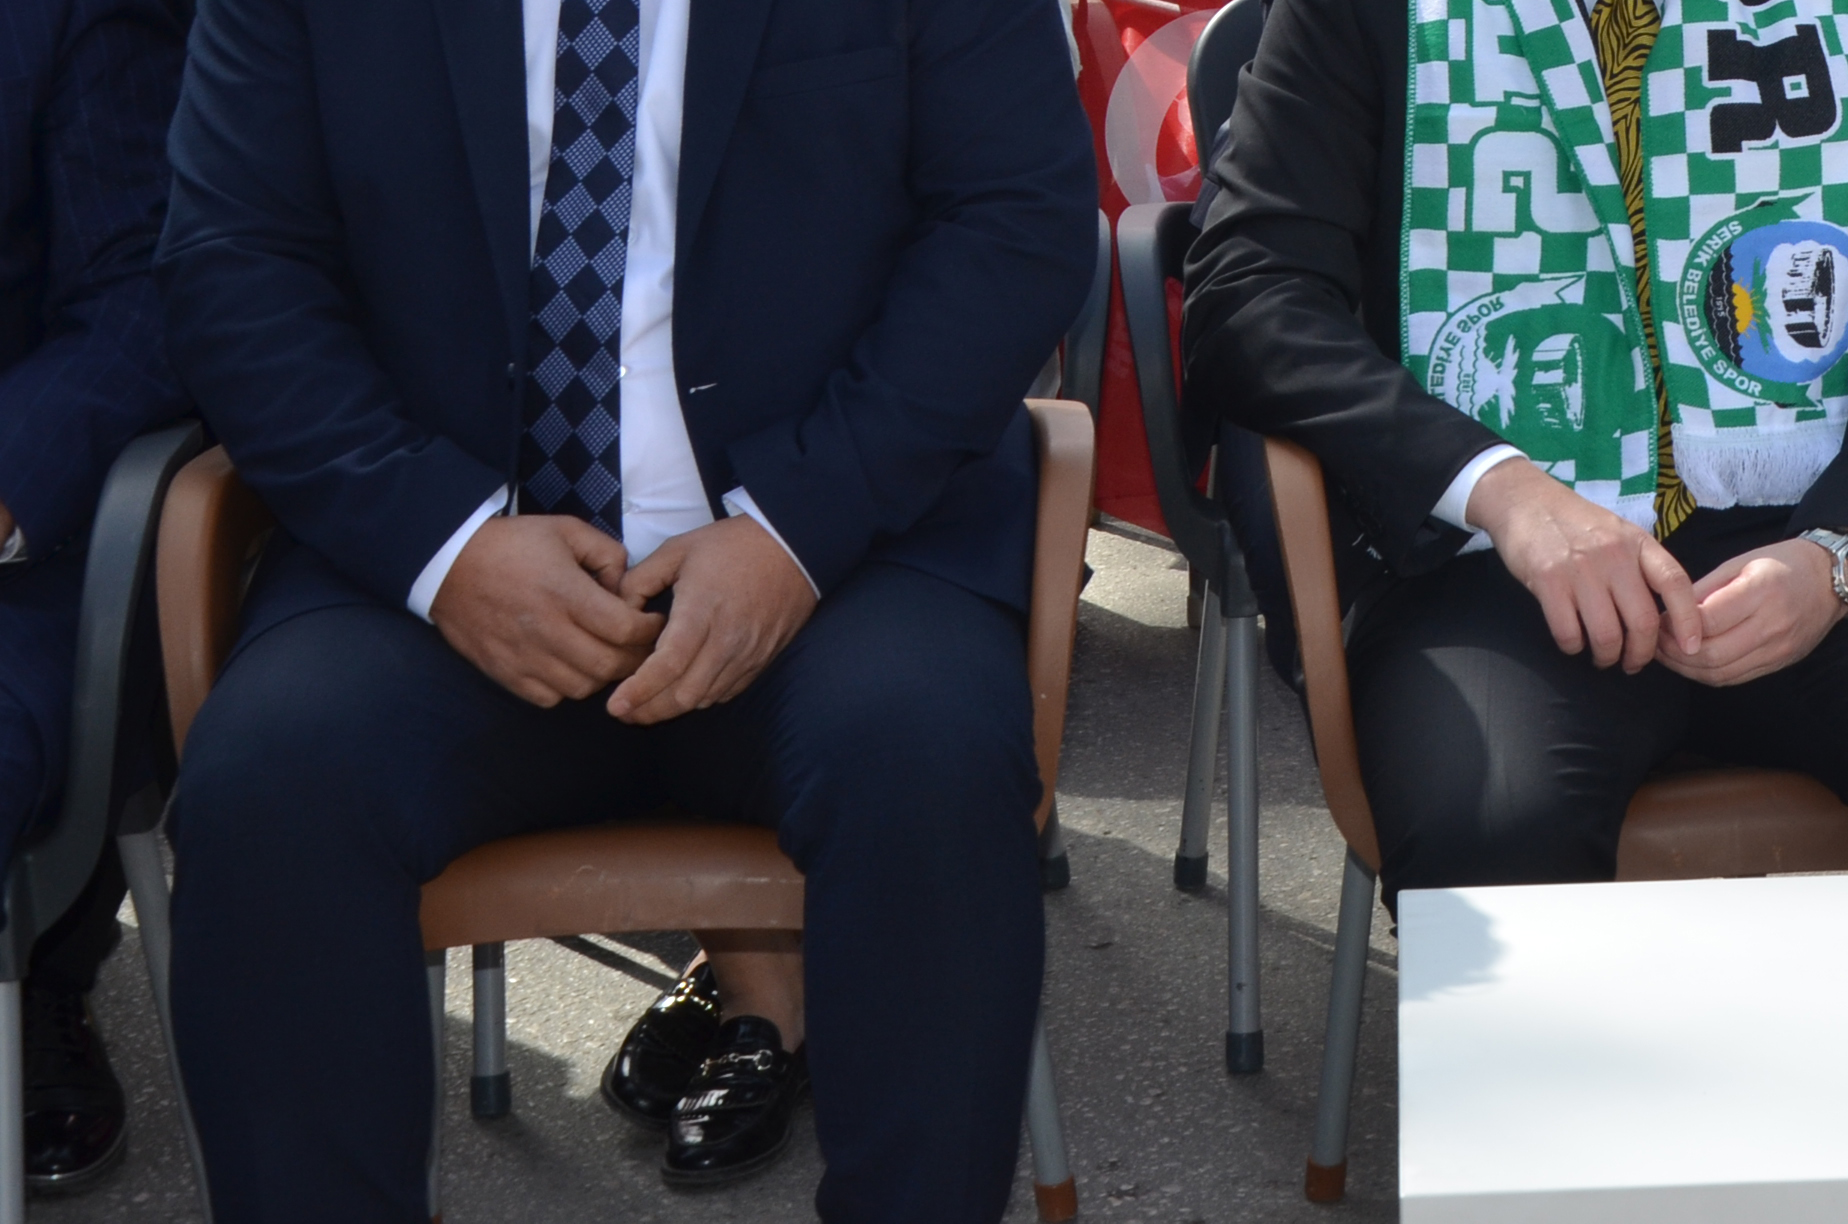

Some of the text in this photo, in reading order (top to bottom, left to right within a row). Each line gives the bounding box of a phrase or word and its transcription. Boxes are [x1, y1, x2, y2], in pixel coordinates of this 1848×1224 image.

[1681, 219, 1763, 397] SERİK BELEDİYE SPOR
